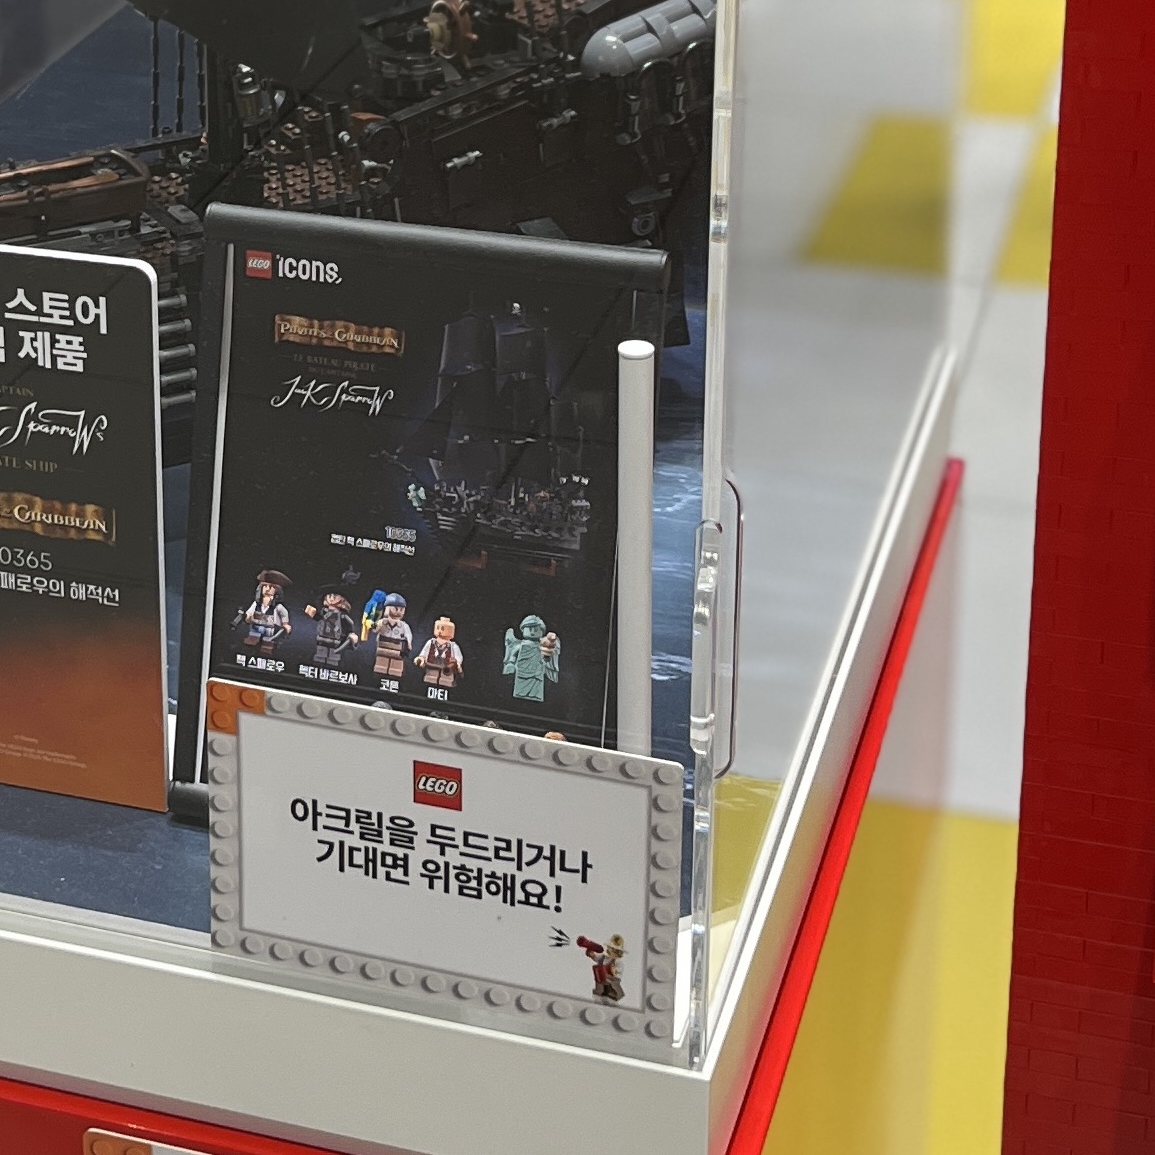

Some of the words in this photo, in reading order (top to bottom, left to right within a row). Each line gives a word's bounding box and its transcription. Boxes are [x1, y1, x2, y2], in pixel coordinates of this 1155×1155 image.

[248, 257, 270, 270] LEGO
[4, 288, 108, 335] 스토어
[18, 331, 88, 373] 제품
[25, 456, 58, 474] SHIP
[70, 582, 120, 607] 해적선
[416, 774, 459, 798] LEGO
[290, 797, 419, 850] 아크릴을
[427, 822, 593, 883] 두드리거나
[315, 838, 410, 886] 기대면
[420, 857, 563, 913] 위험해요!
